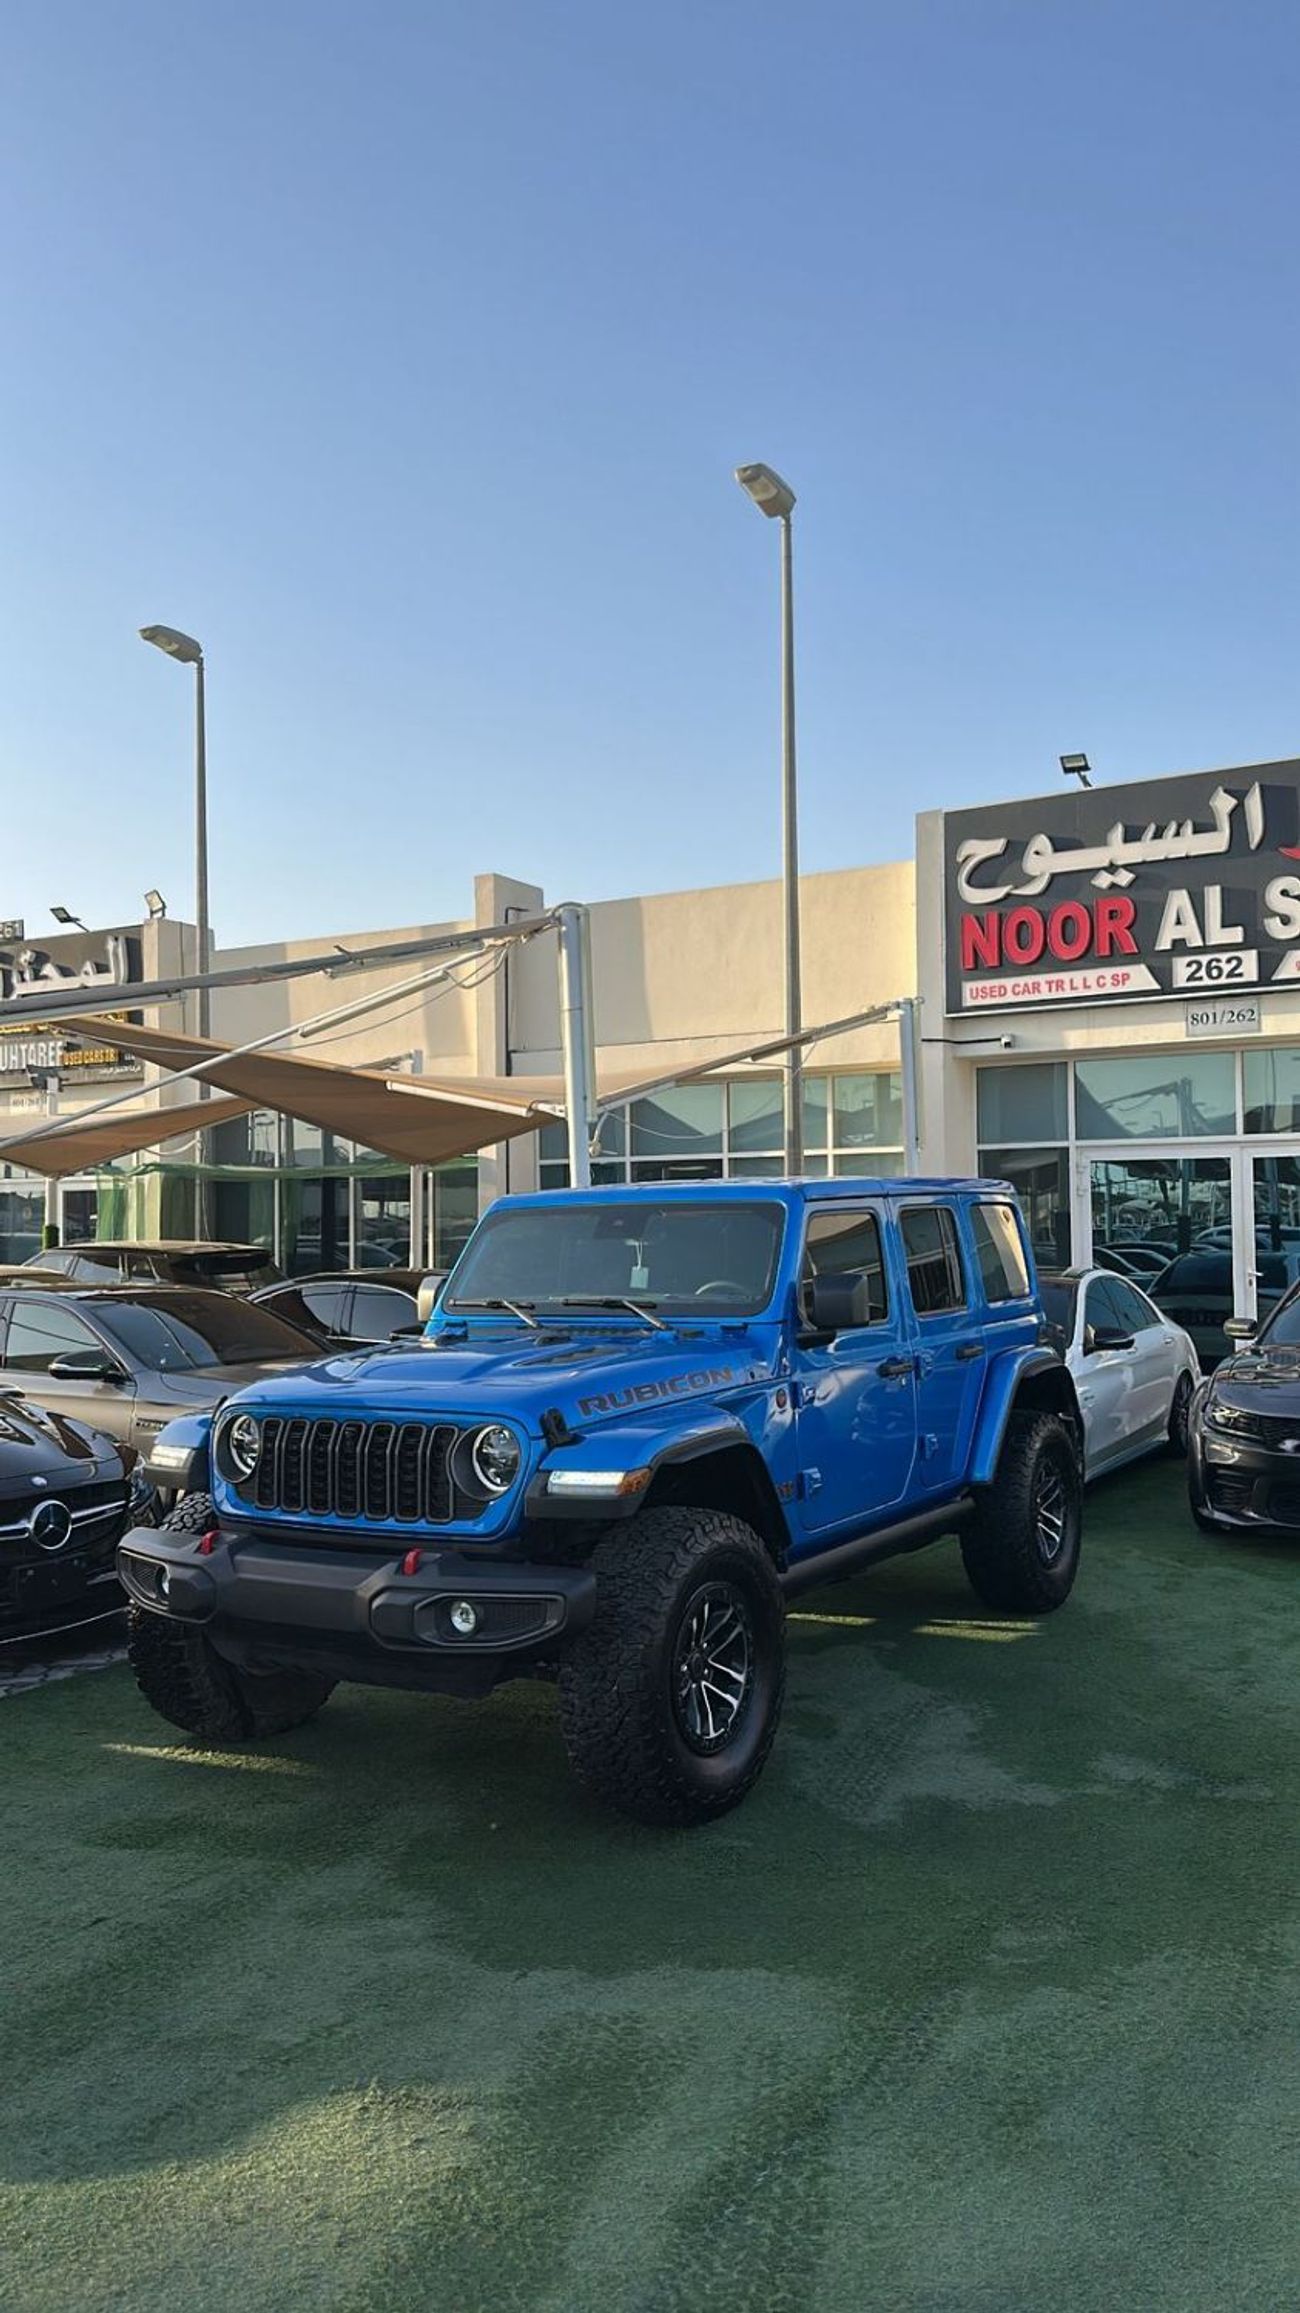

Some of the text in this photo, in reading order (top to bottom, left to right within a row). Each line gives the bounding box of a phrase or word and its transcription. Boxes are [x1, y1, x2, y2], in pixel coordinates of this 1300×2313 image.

[961, 895, 1138, 970] NOOR
[1154, 885, 1245, 951] AL
[1185, 956, 1244, 983] 262
[969, 973, 1131, 1000] USED CAR TR L L C SP
[1190, 1008, 1257, 1026] 801/262
[577, 1367, 733, 1417] RUBICON
